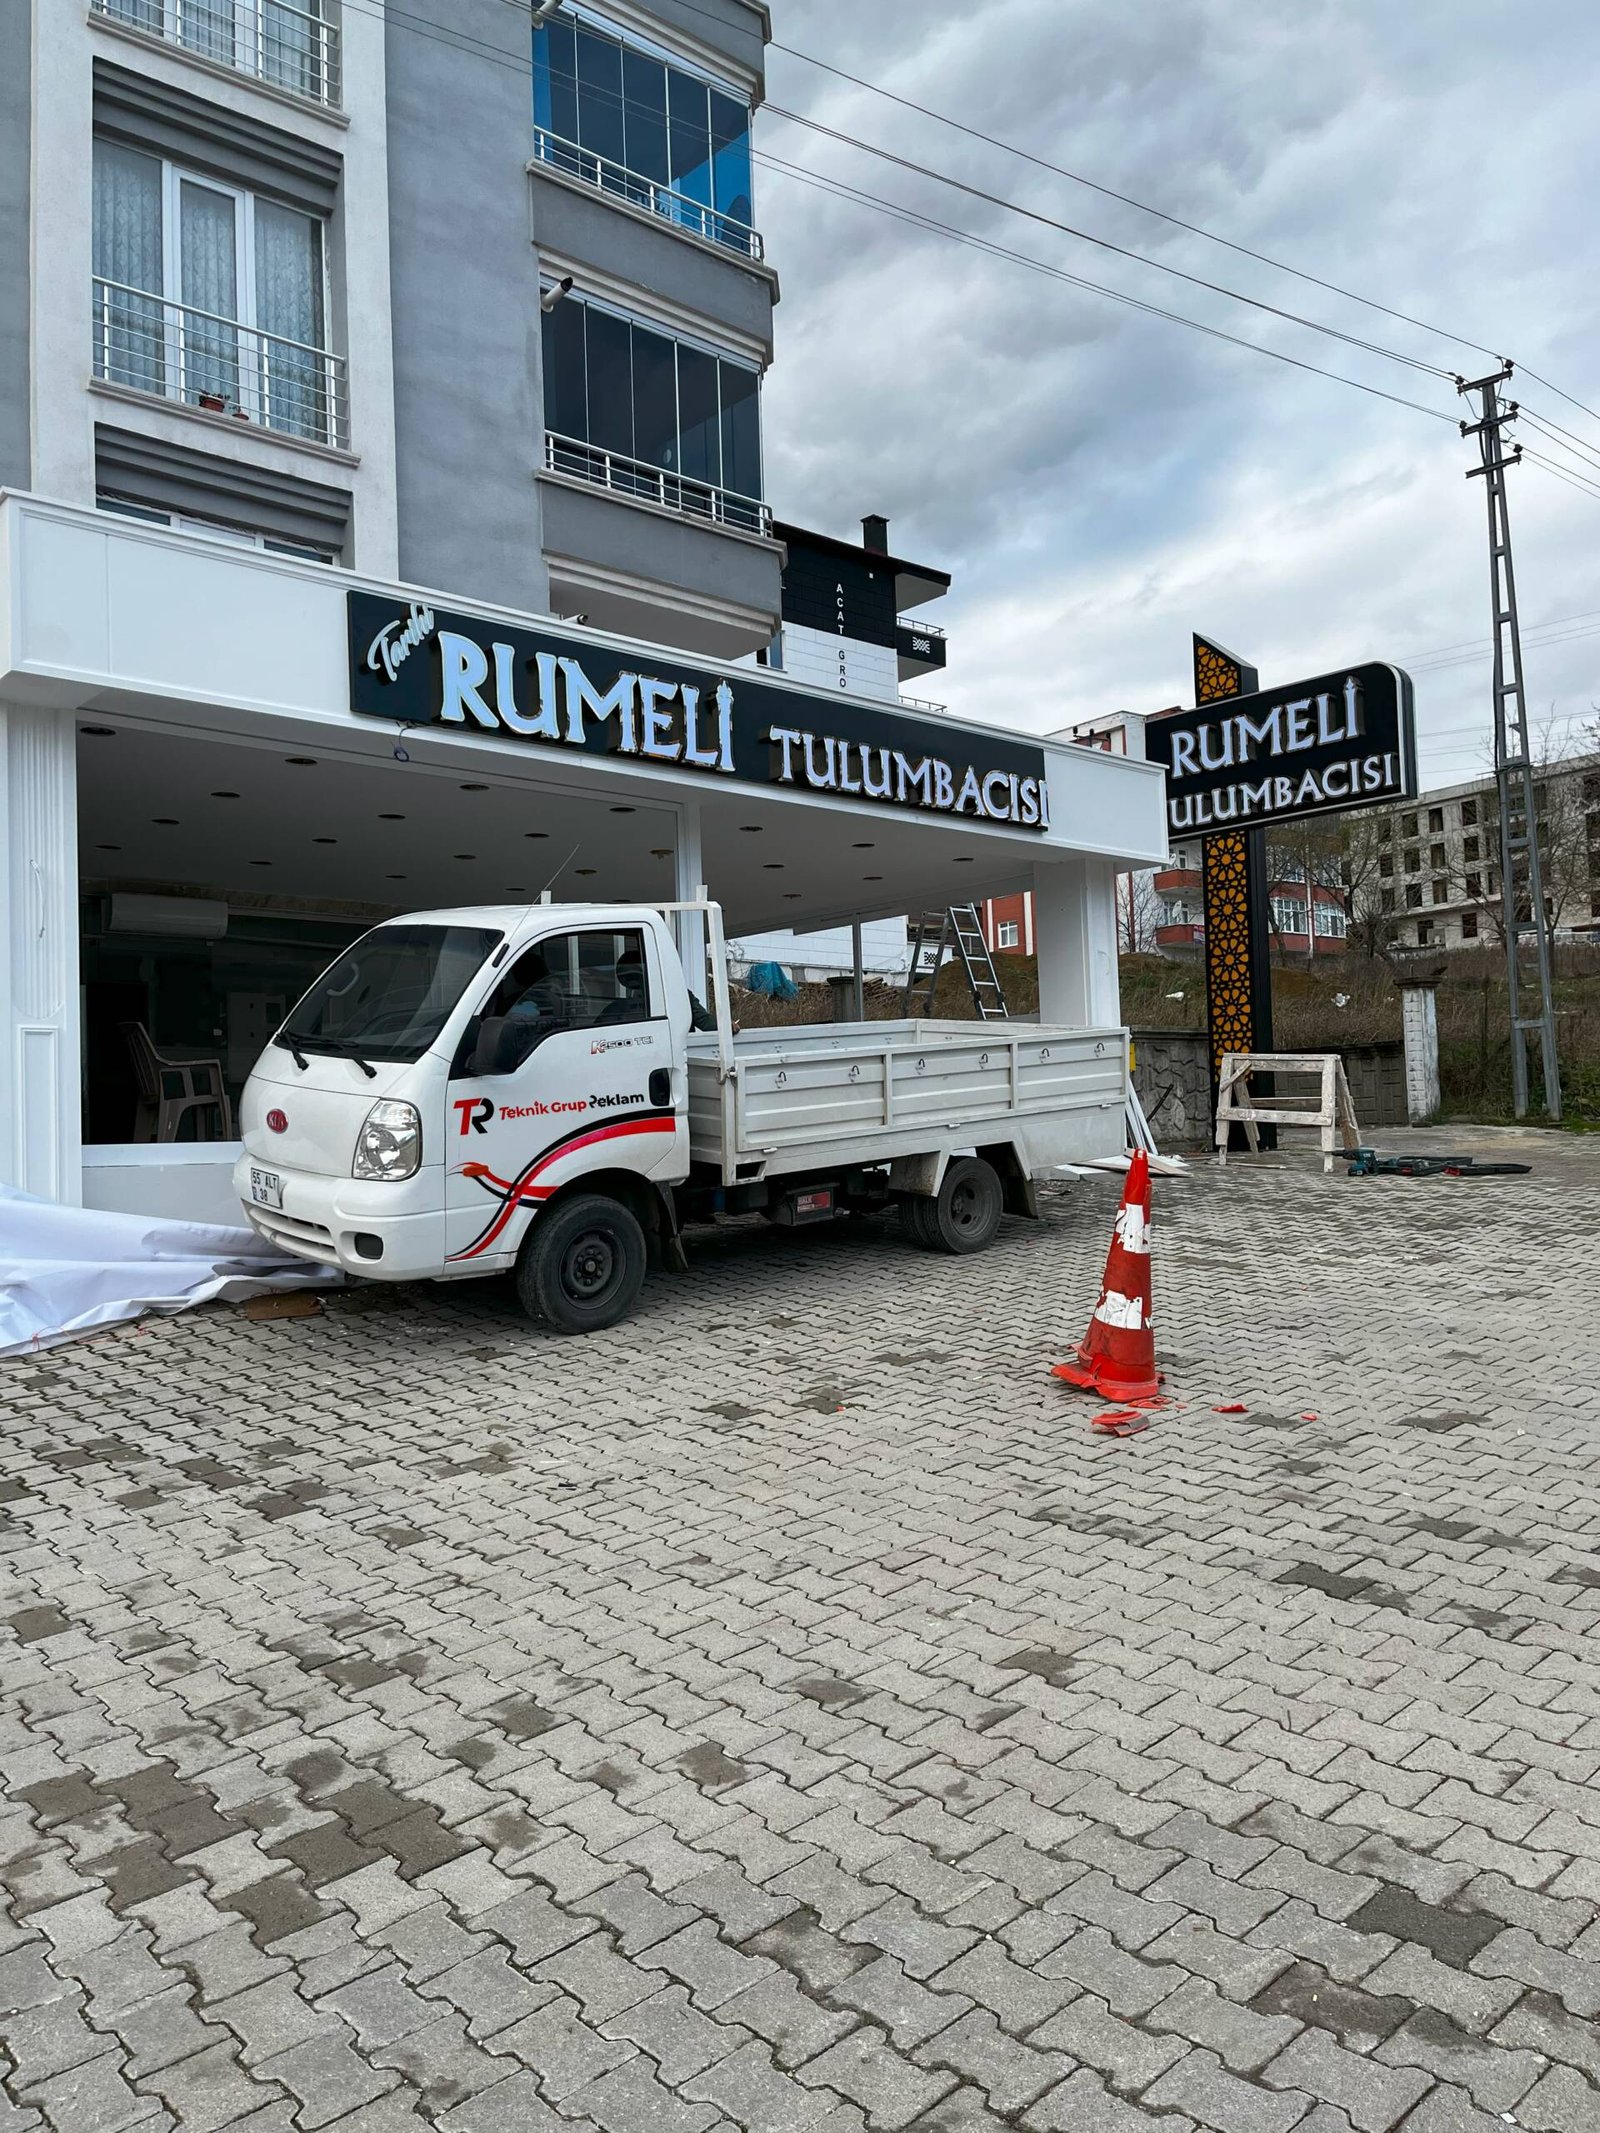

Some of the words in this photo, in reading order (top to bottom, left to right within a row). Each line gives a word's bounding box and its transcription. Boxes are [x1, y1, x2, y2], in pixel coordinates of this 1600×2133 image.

[836, 583, 845, 635] ACAT
[768, 724, 1050, 827] TULUMBACISI
[1168, 752, 1395, 829] ULUMBACISI
[453, 1097, 495, 1136] TR
[499, 1102, 549, 1121] Teknik
[550, 1101, 587, 1115] Grup
[589, 1093, 645, 1109] Reklam
[252, 1171, 261, 1185] 55
